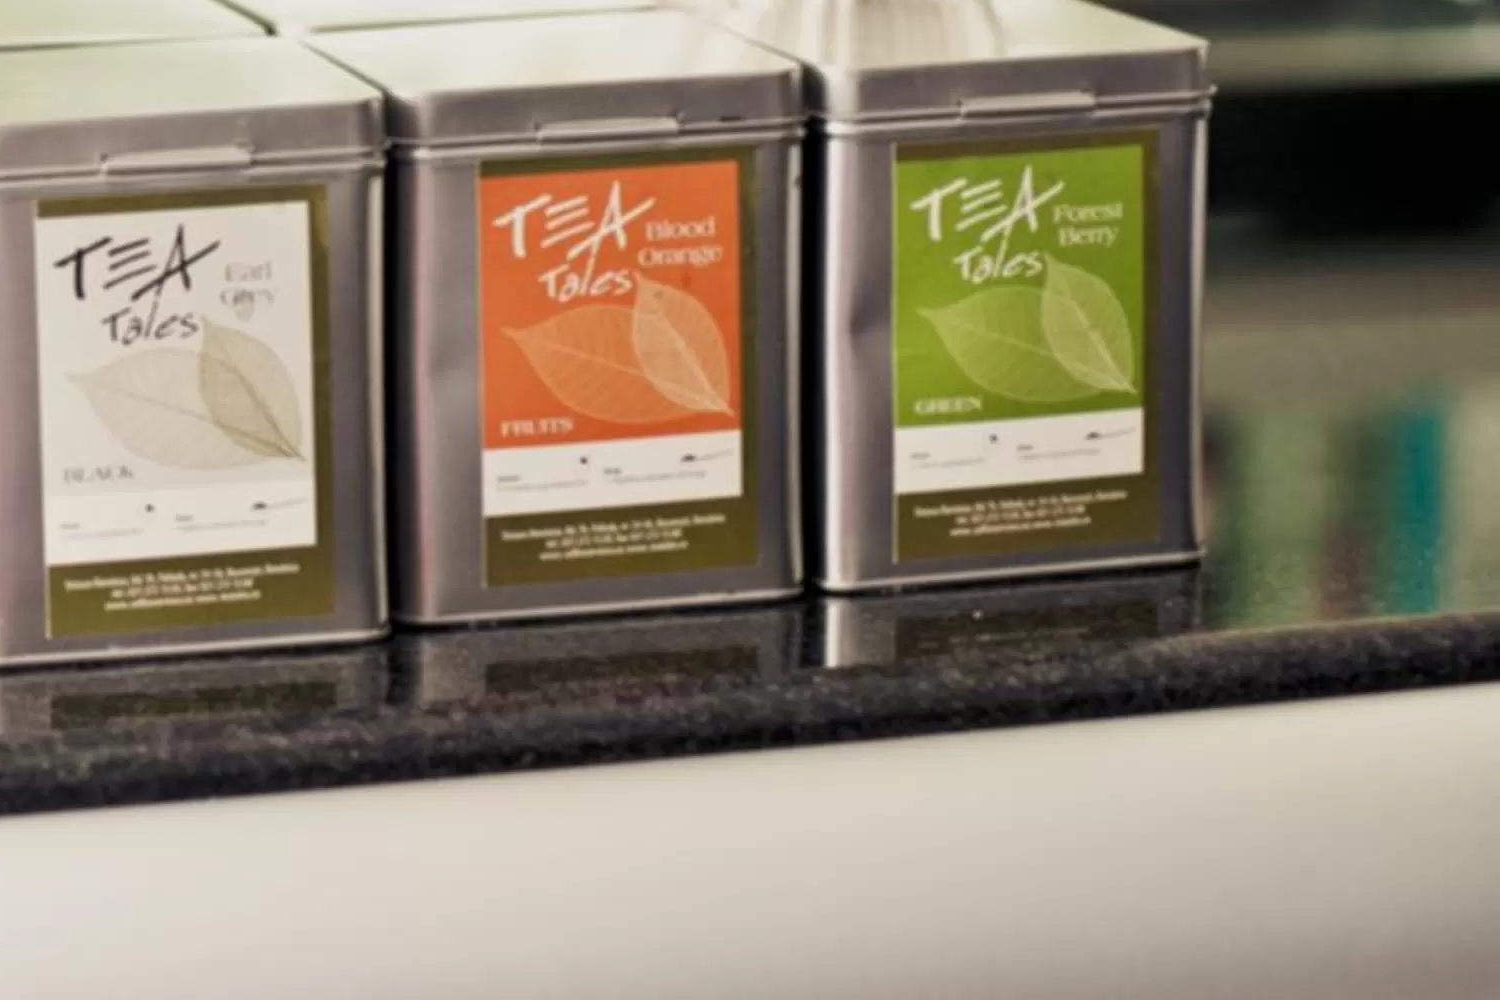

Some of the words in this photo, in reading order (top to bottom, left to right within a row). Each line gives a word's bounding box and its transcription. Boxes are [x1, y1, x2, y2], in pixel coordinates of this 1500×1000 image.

[910, 165, 1065, 243] TEA
[1053, 202, 1123, 223] Forest
[492, 180, 656, 261] TEA
[646, 215, 716, 240] Blood
[1059, 227, 1119, 248] Berry
[54, 223, 220, 302] TEA
[638, 245, 723, 267] Orange
[953, 244, 1043, 284] Tales
[224, 260, 272, 282] Earl
[539, 261, 633, 302] Tales
[102, 303, 199, 345] Tales
[914, 396, 982, 415] GREEN
[501, 417, 573, 438] FRUITS
